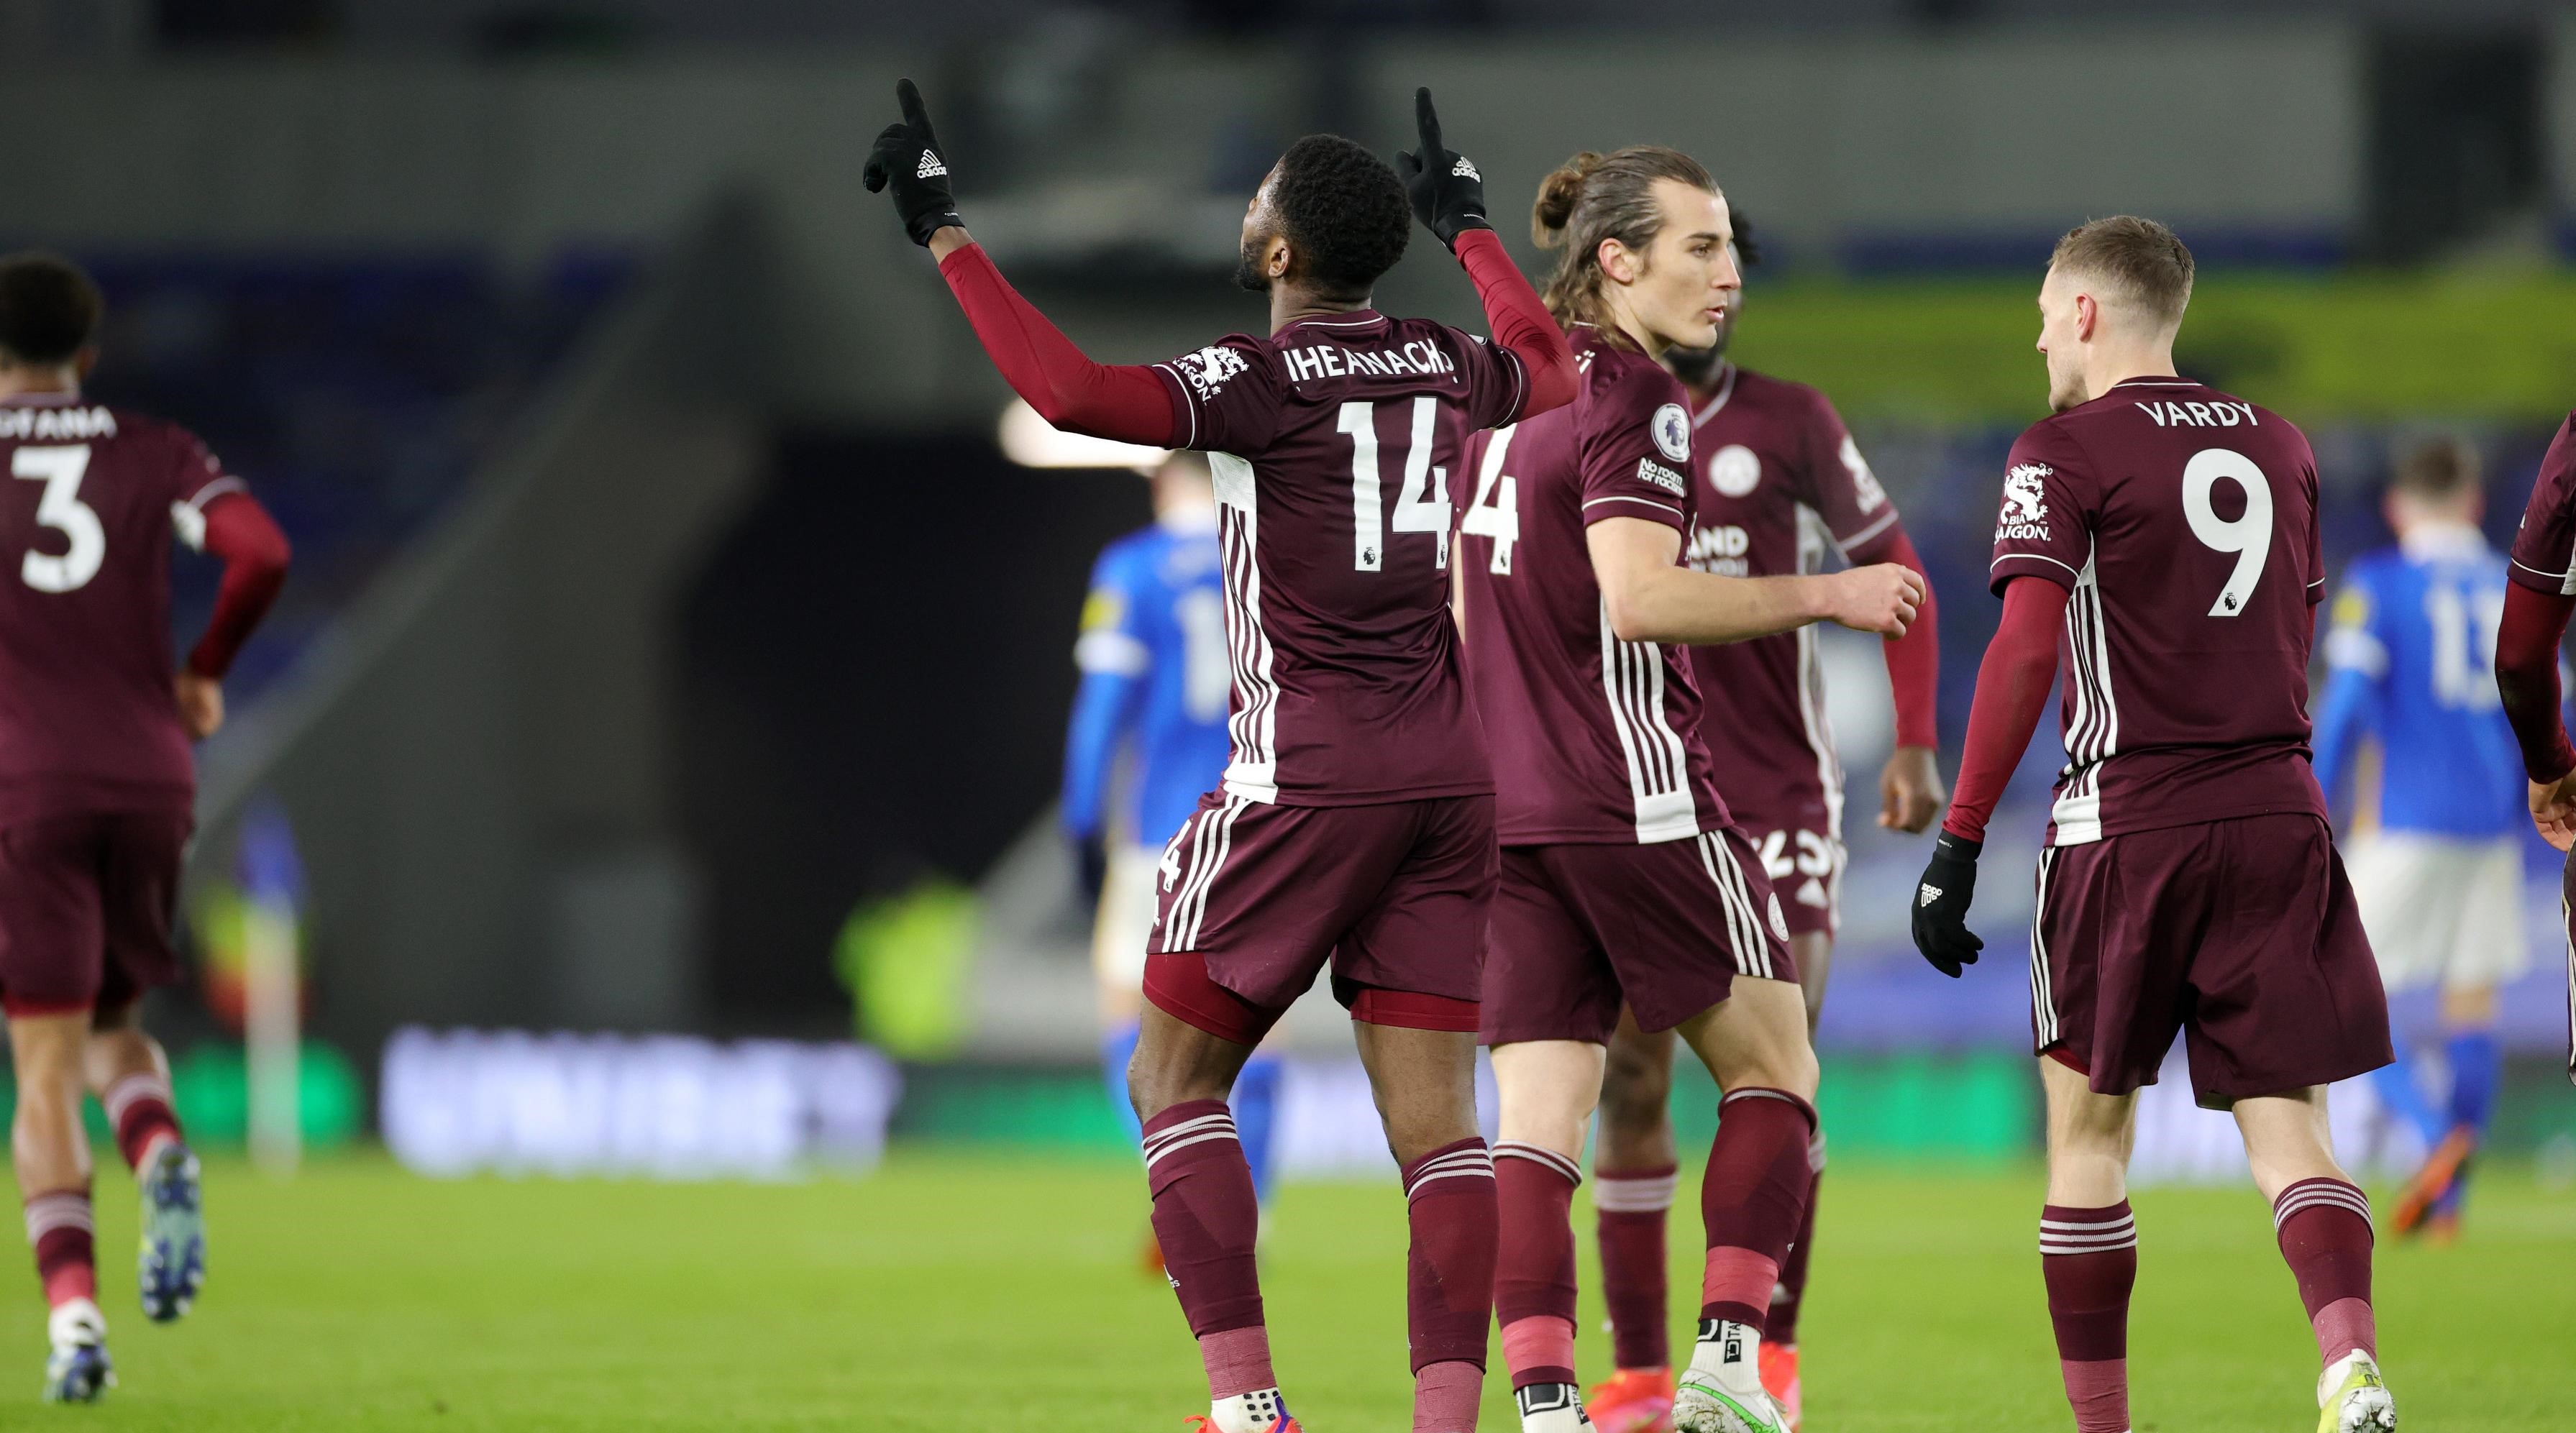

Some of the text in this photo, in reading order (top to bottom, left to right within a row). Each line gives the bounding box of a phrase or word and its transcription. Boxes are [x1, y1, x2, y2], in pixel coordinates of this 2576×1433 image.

[917, 166, 947, 178] adidas
[2135, 401, 2259, 427] VARDY
[1337, 395, 1452, 572] 14
[1637, 469, 1655, 482] for
[1640, 457, 1684, 486] No room
[11, 443, 106, 594] 3
[2009, 514, 2026, 525] BIA
[2182, 448, 2274, 617] 9
